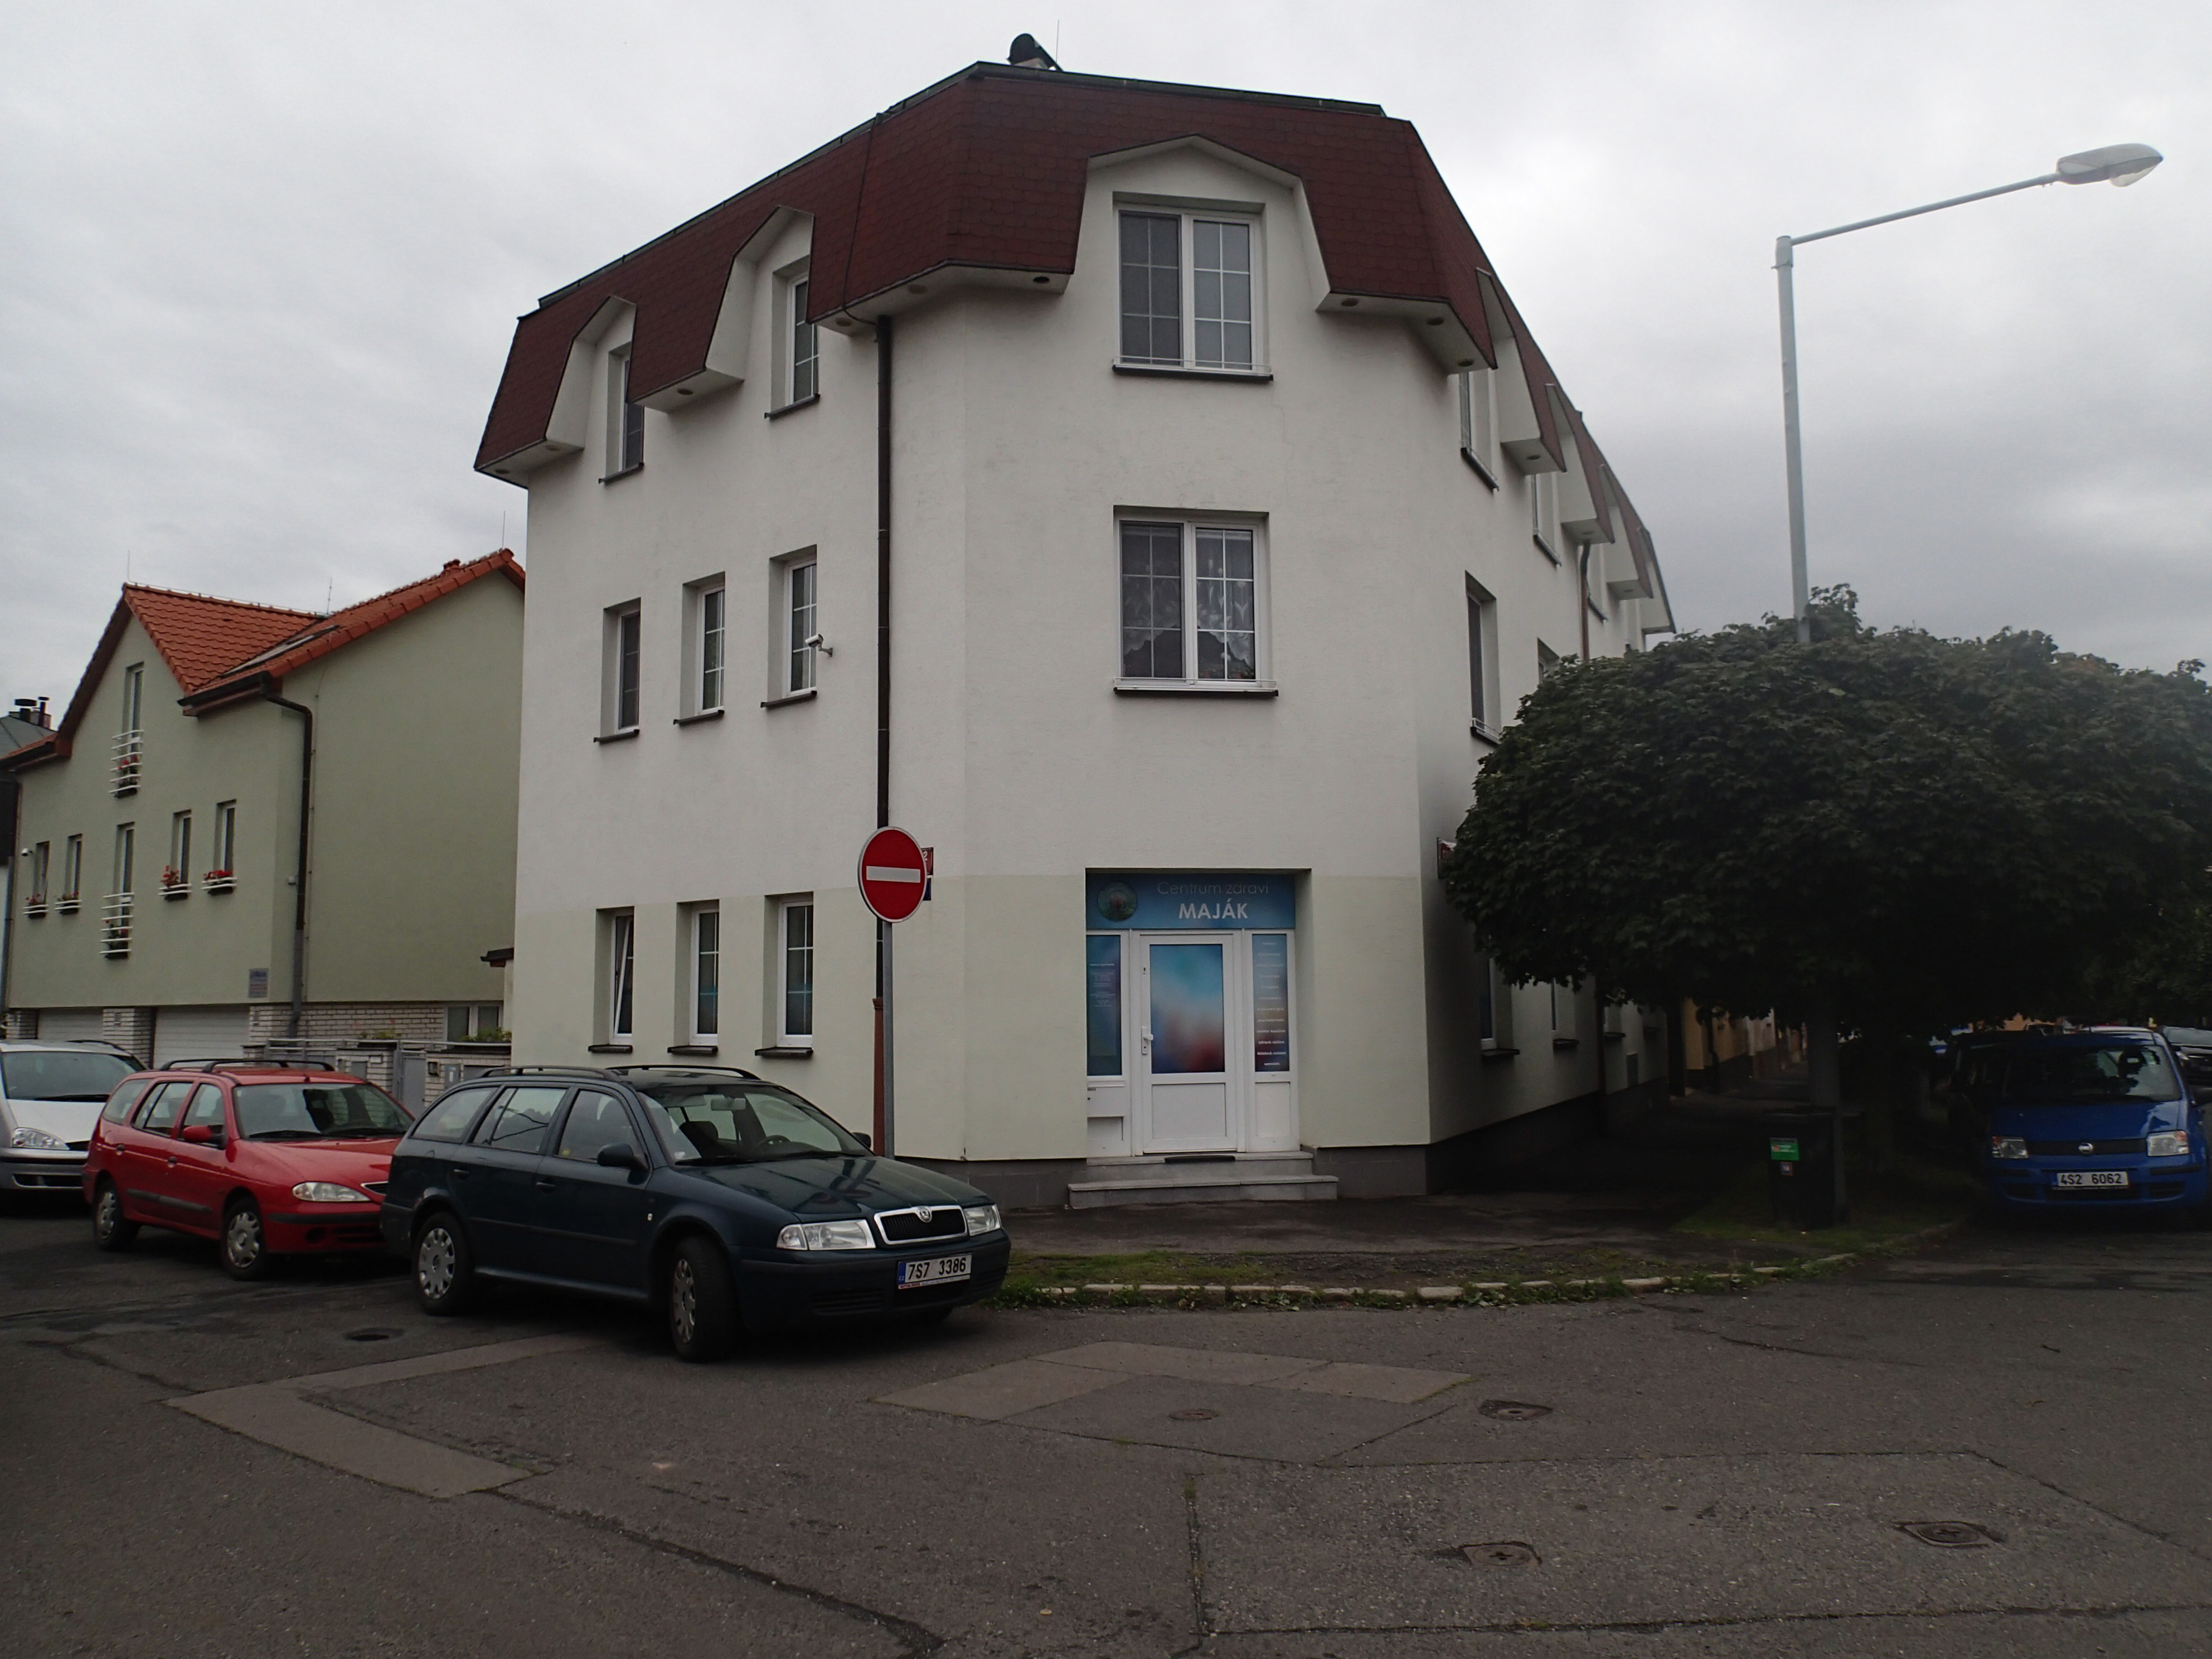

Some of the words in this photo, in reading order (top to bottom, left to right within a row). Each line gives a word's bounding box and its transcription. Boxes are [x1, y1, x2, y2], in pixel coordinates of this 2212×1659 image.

[1157, 881, 1221, 895] Centrum
[1178, 898, 1249, 919] MAJÁK
[2060, 1173, 2083, 1185] 4S2
[2091, 1173, 2122, 1184] 6062
[909, 1262, 930, 1280] 7S7
[939, 1257, 967, 1275] 3386
